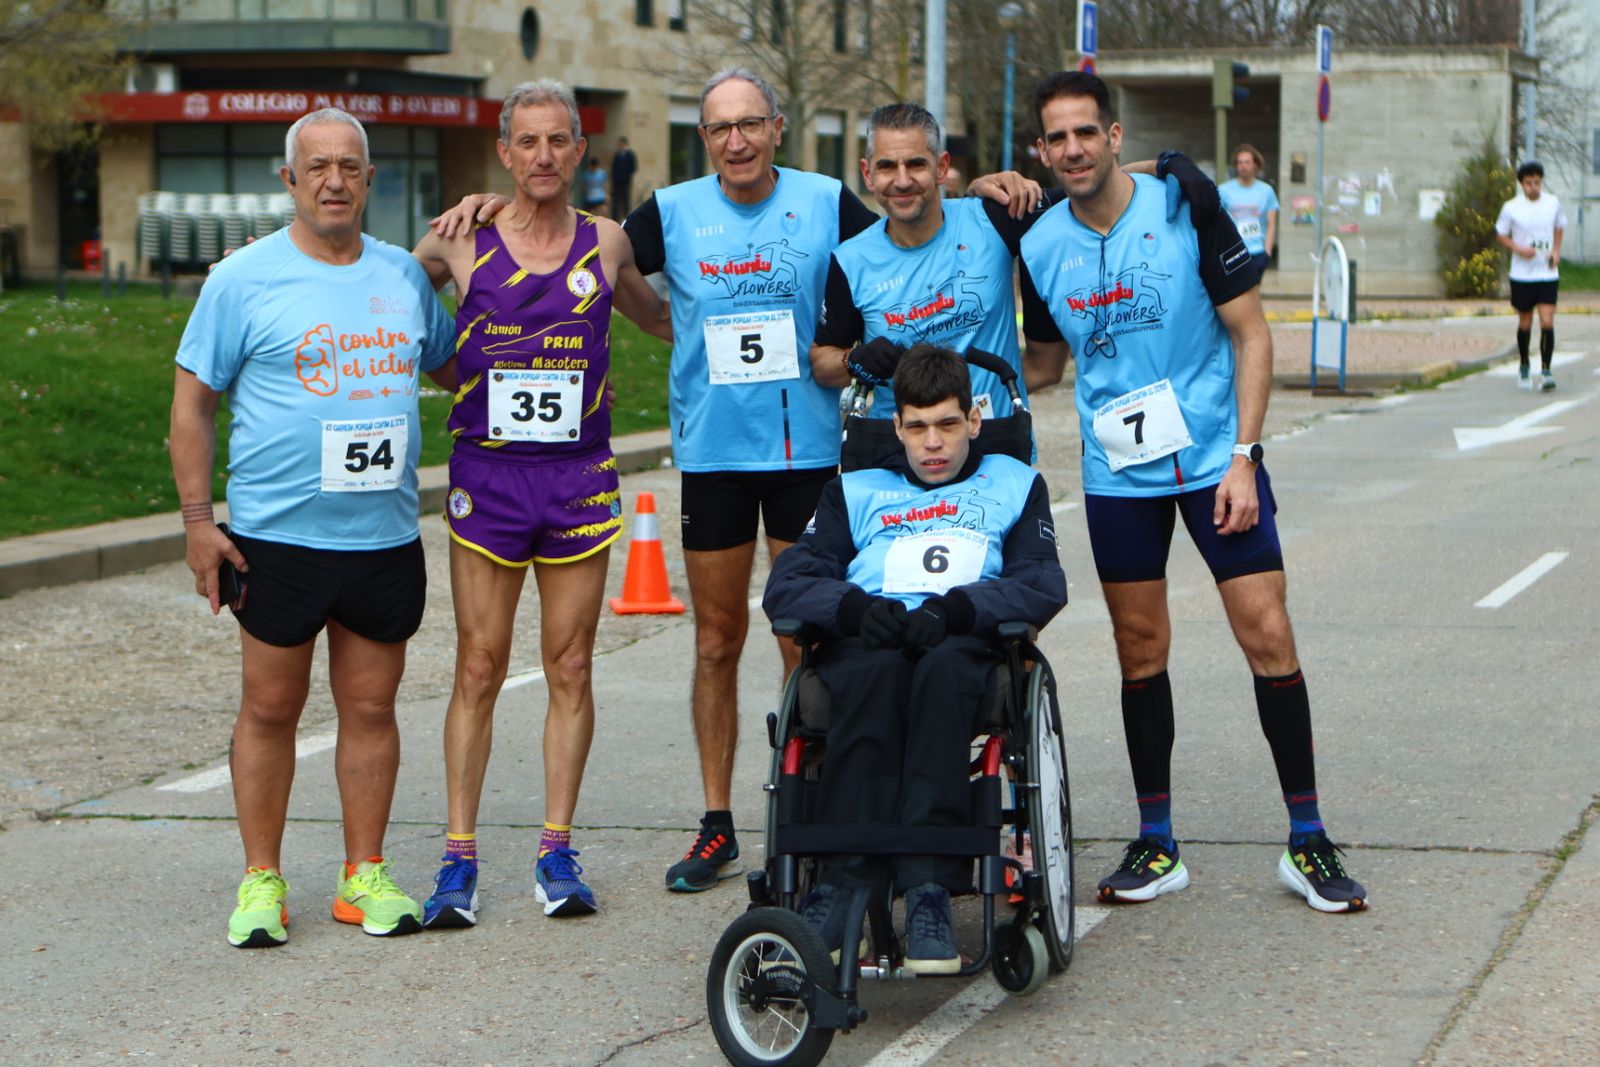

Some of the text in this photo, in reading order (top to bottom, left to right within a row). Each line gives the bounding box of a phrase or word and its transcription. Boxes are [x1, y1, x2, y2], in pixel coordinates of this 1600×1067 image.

[219, 93, 307, 113] COLEGIO
[735, 280, 791, 297] FLOWERS
[484, 322, 522, 335] Jamón
[925, 309, 978, 336] FLOWERS
[339, 326, 410, 352] contra
[543, 336, 584, 349] PRIM
[740, 333, 764, 364] 5
[342, 352, 414, 378] el ictus
[532, 356, 589, 369] Macotera
[511, 391, 562, 422] 35
[1122, 411, 1145, 445] 7
[344, 439, 394, 473] 54
[922, 545, 950, 574] 6
